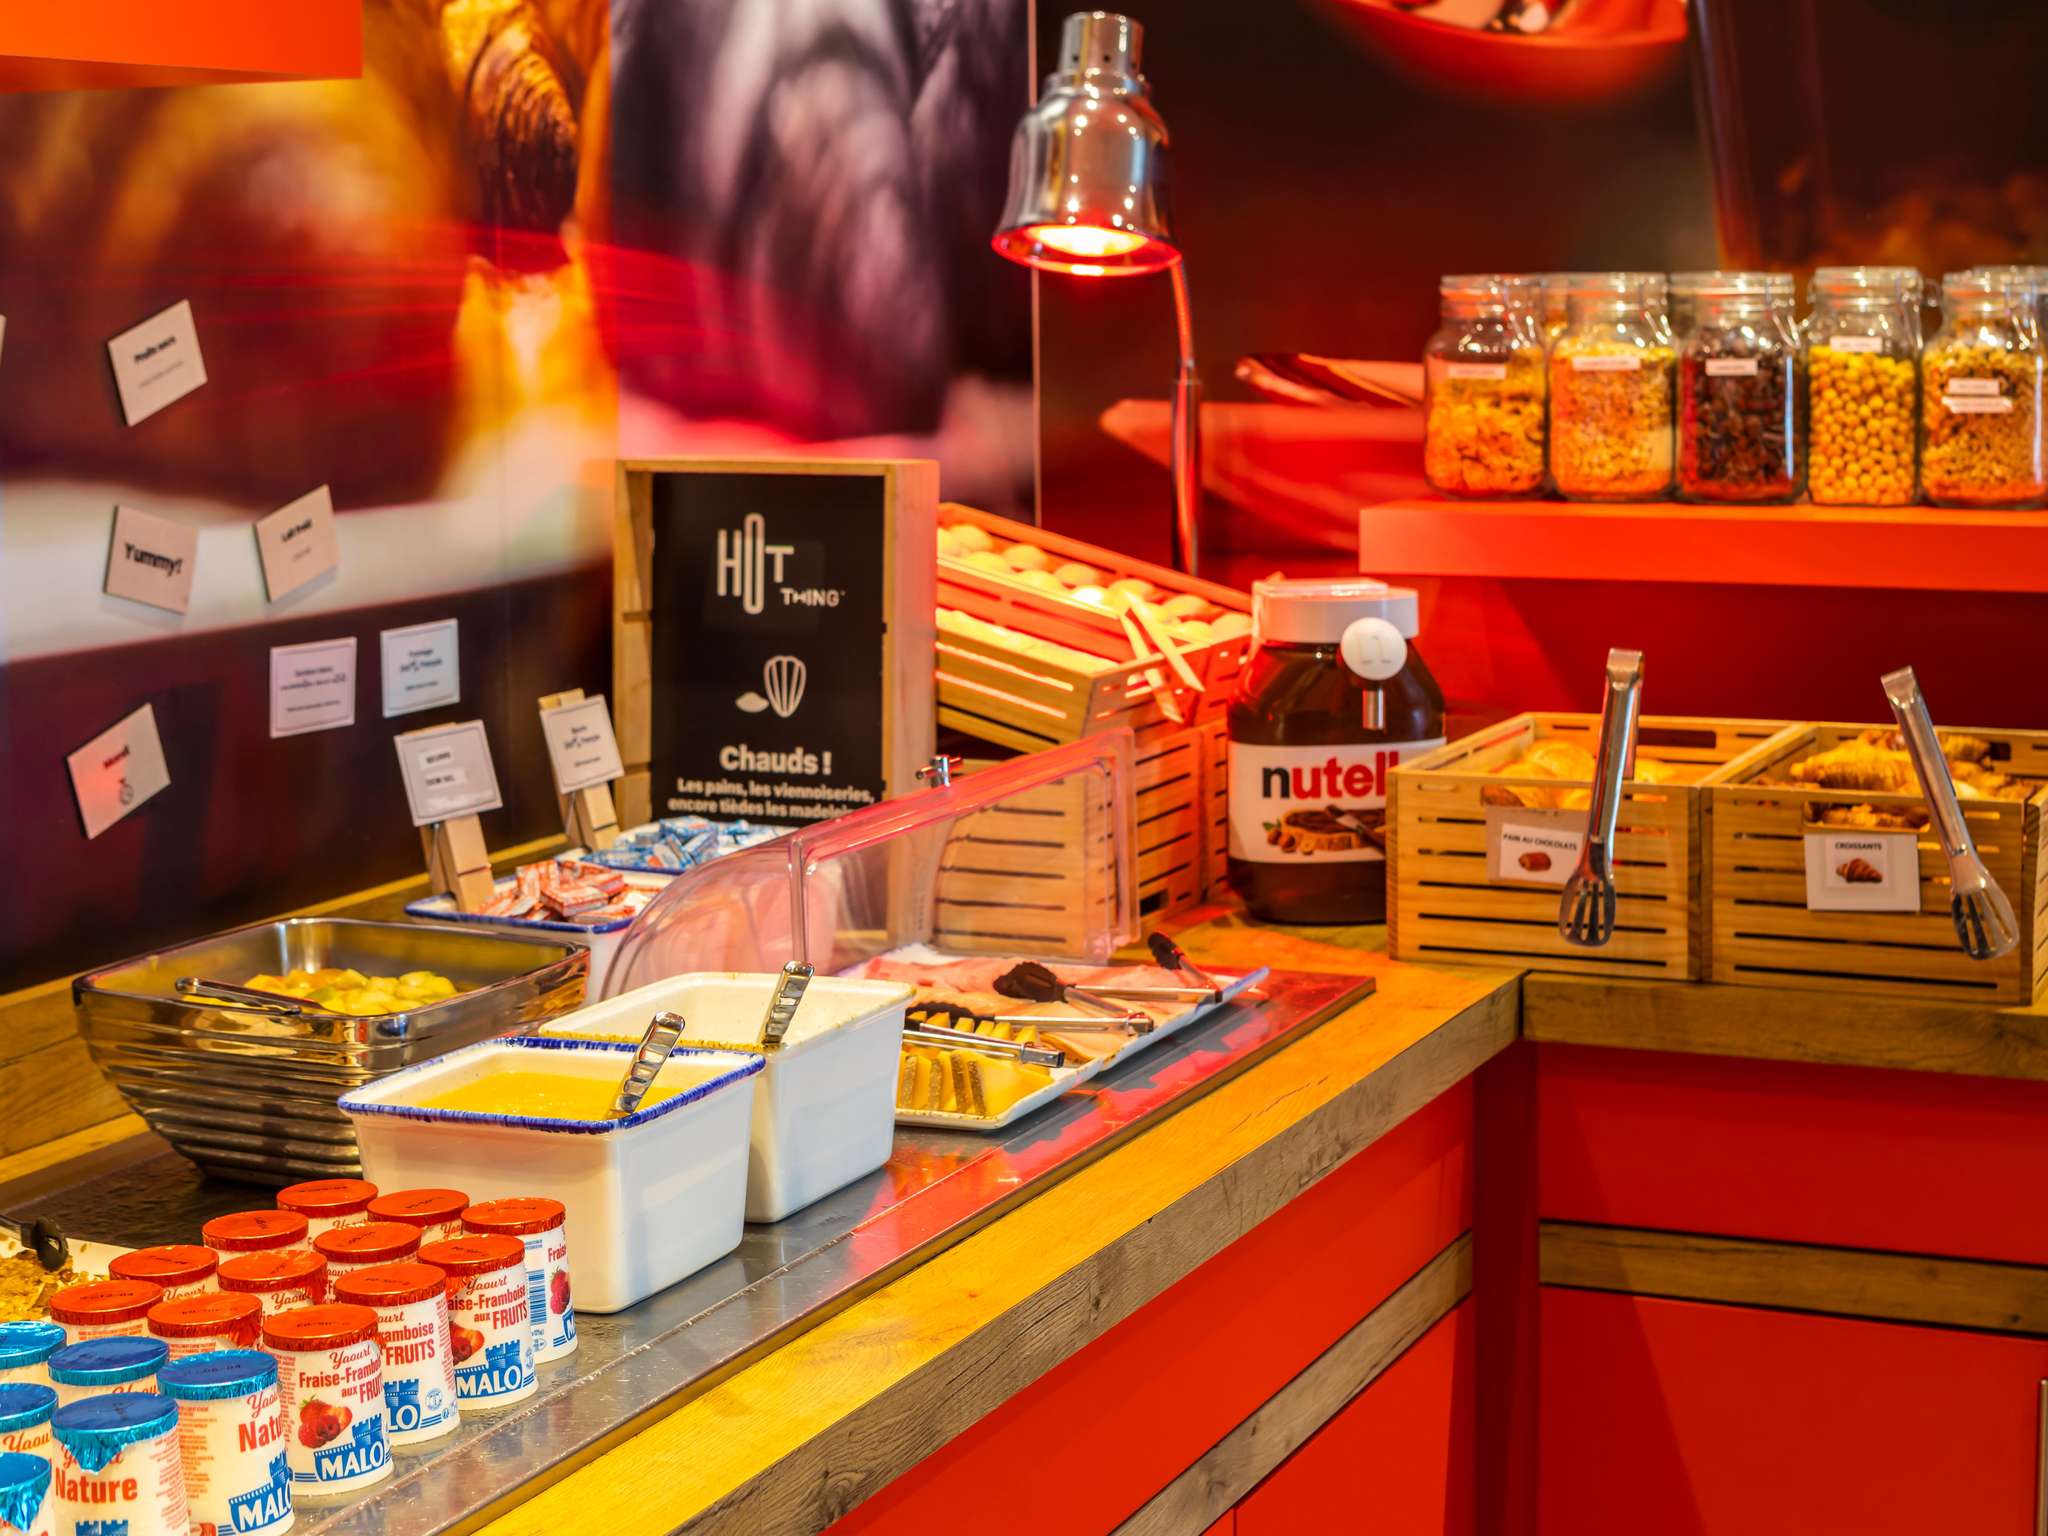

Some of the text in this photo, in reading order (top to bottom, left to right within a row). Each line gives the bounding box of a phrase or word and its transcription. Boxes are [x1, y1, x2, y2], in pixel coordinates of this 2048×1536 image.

[124, 541, 184, 578] Yummy!
[717, 513, 795, 614] HOT
[780, 587, 840, 607] THING
[719, 743, 819, 774] Chauds
[677, 777, 874, 804] Les pains, les viennoiseries,
[667, 798, 717, 812] encore
[718, 798, 763, 816] tièdes
[764, 800, 786, 816] les
[1522, 836, 1533, 844] AU
[1534, 837, 1578, 851] CHOCOLATS
[1834, 840, 1882, 850] CROISSANTS
[473, 1301, 528, 1330] aux FRUITS
[329, 1345, 371, 1370] Yaourt
[385, 1338, 436, 1367] FRUITS
[341, 1385, 358, 1398] aux
[456, 1364, 522, 1397] MALO
[320, 1440, 384, 1481] MALO
[54, 1467, 139, 1505] Nature
